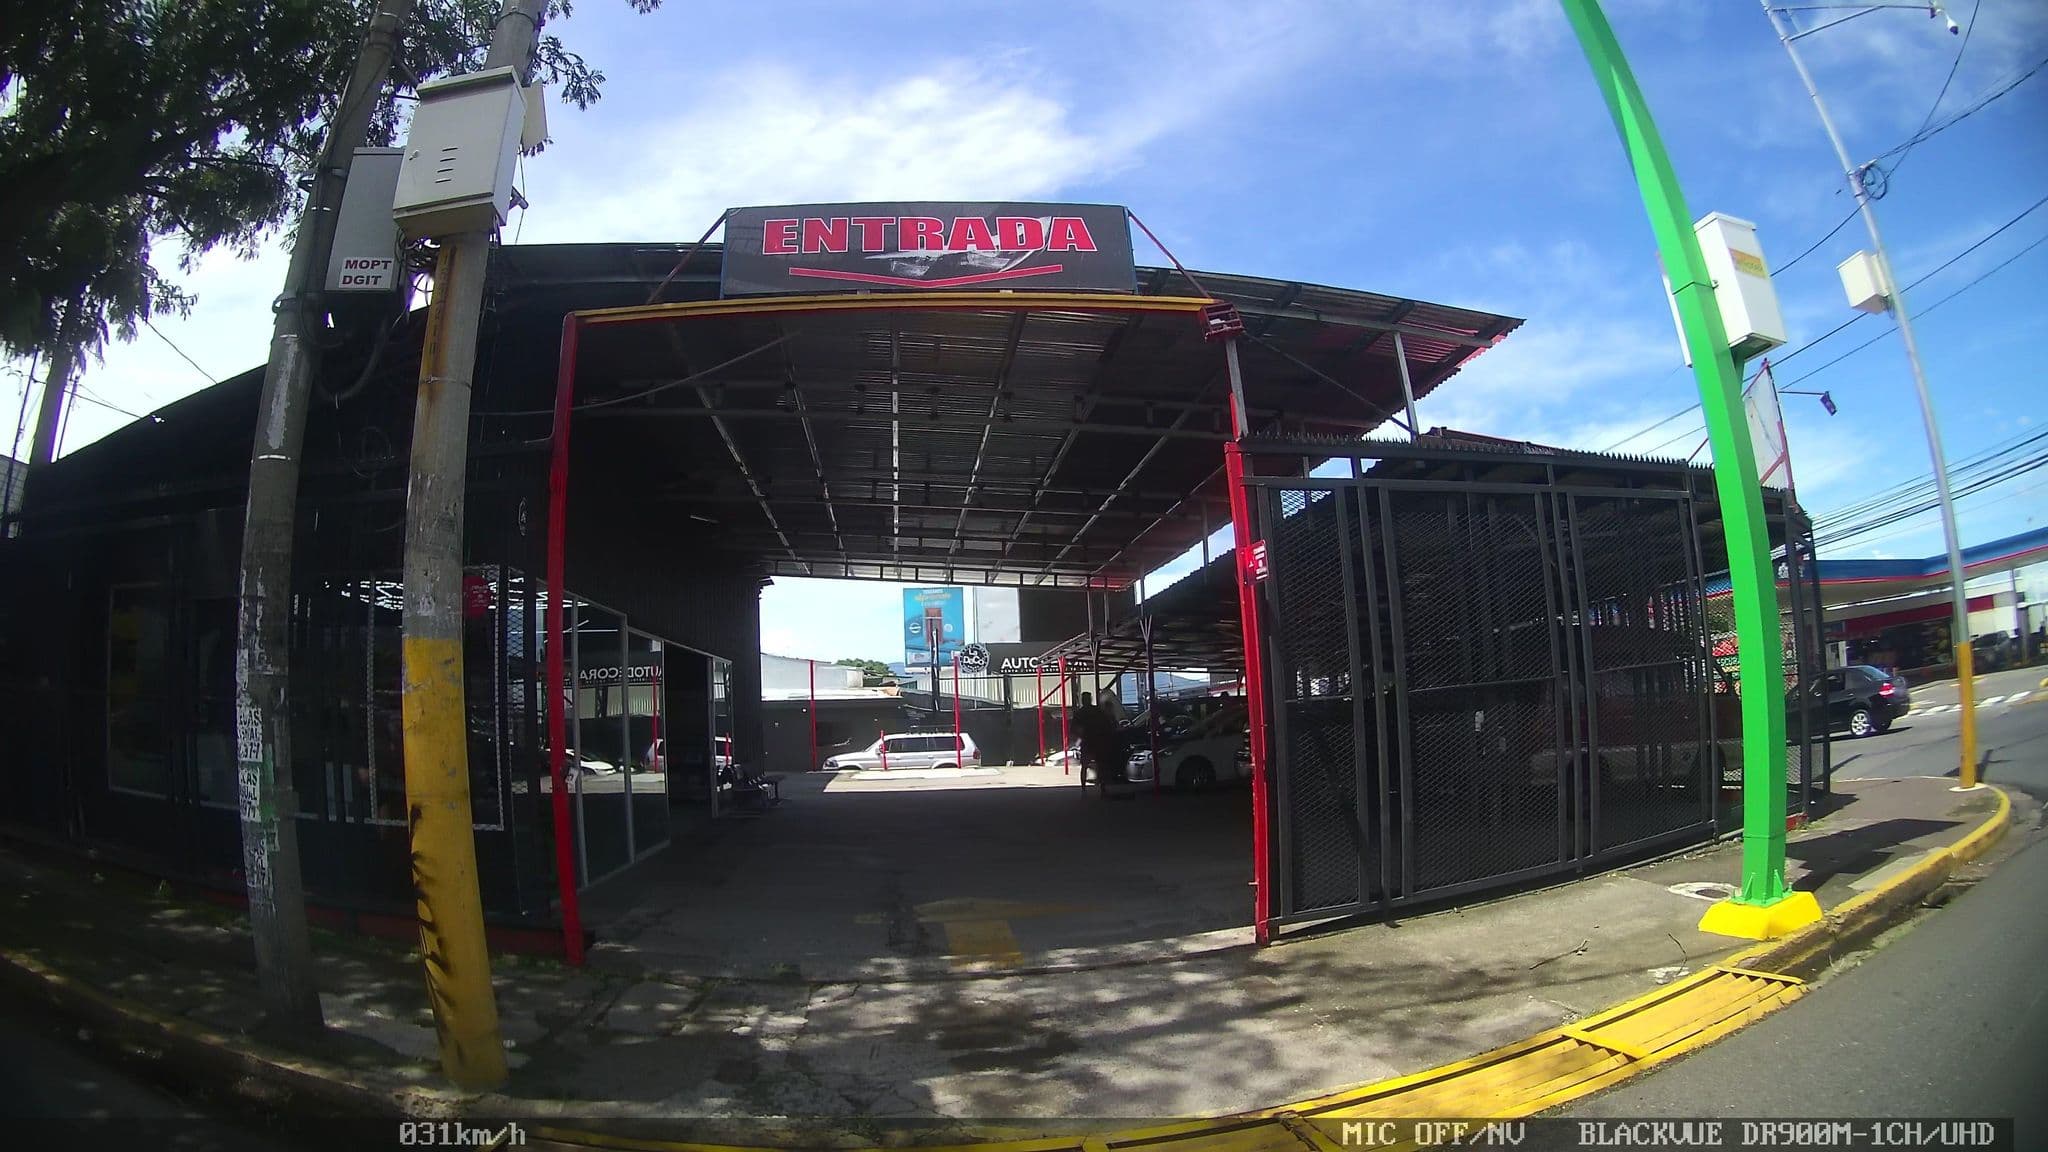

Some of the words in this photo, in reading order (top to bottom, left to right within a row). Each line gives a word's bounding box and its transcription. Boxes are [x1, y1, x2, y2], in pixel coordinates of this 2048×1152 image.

[763, 217, 1097, 255] ENTRADA
[345, 260, 392, 270] MOPT
[342, 275, 382, 285] DGIT
